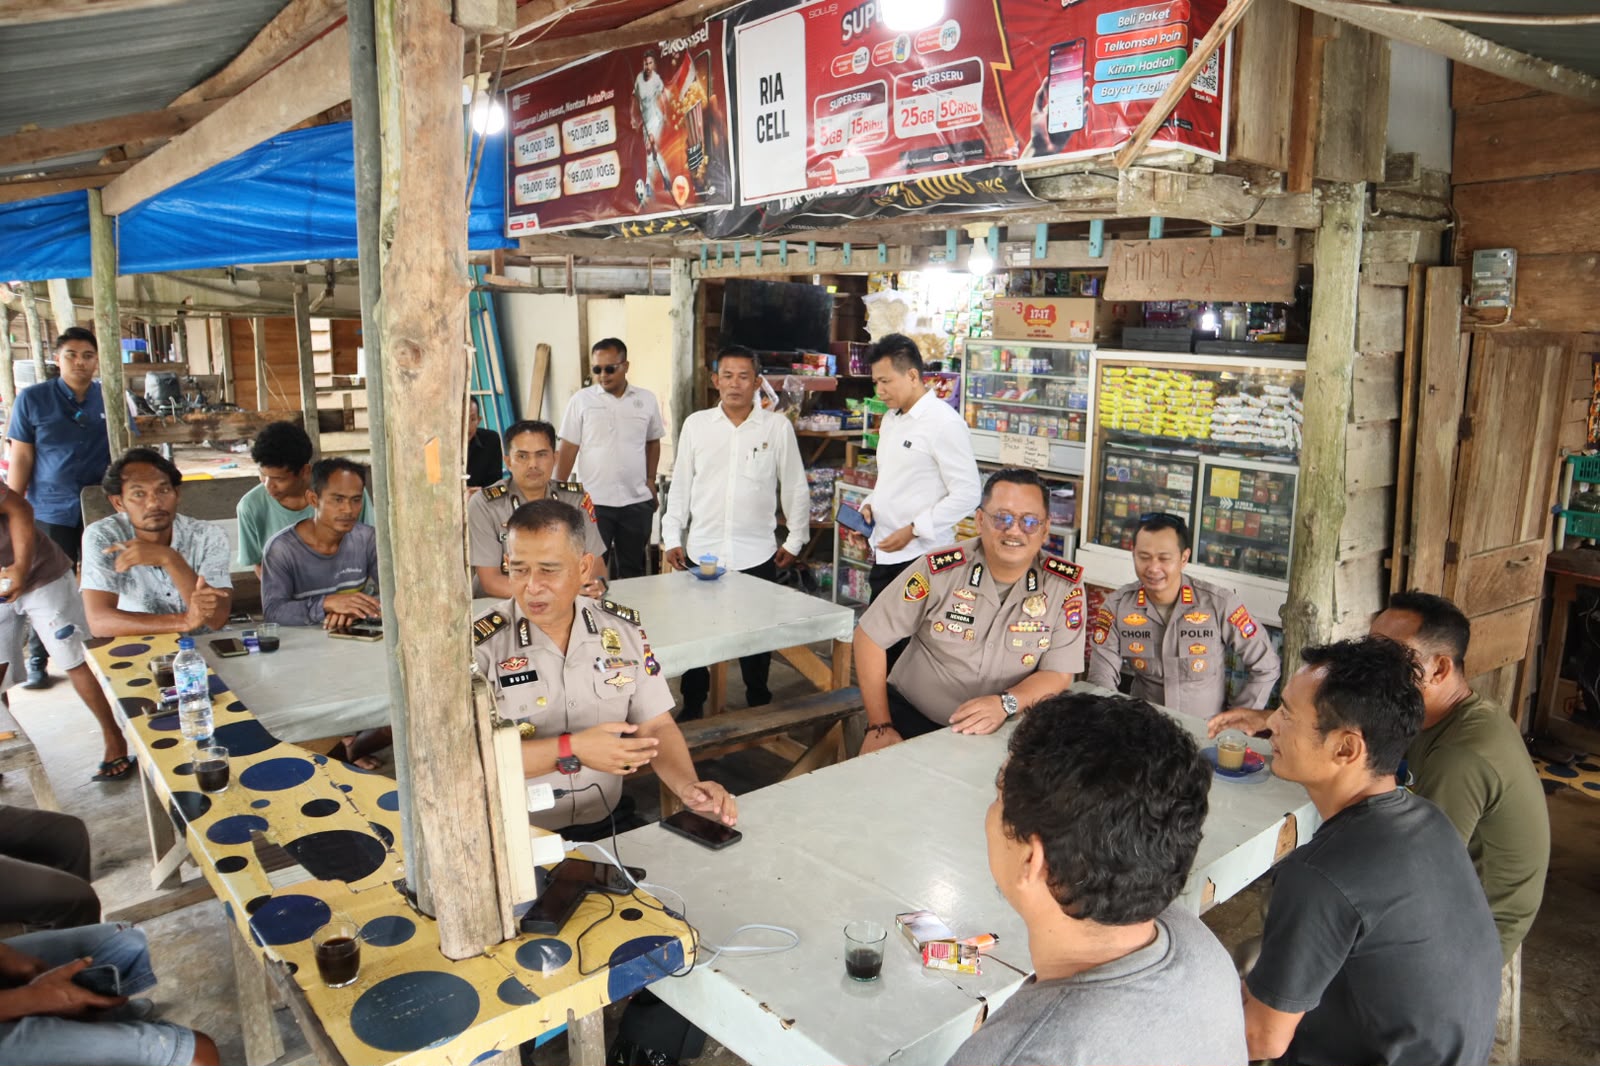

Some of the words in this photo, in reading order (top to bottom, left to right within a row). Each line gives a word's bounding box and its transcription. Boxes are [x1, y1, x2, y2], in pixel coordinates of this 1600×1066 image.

[1118, 13, 1137, 27] Beli
[1138, 8, 1170, 26] Paket
[1104, 35, 1158, 53] Telkomsel
[1160, 29, 1181, 45] Poin
[1108, 62, 1136, 75] Kirim
[1138, 55, 1175, 72] Hadiah
[760, 72, 784, 106] RIA
[912, 73, 942, 92] SUPER
[942, 70, 964, 83] SERU
[1101, 84, 1133, 97] Bayar
[829, 94, 852, 112] SUPER
[852, 92, 871, 104] SERU
[757, 109, 790, 144] CELL
[901, 106, 935, 128] 25GB
[1121, 629, 1151, 639] CHOIR
[1180, 629, 1214, 639] POLRI
[509, 673, 530, 684] BUDI
